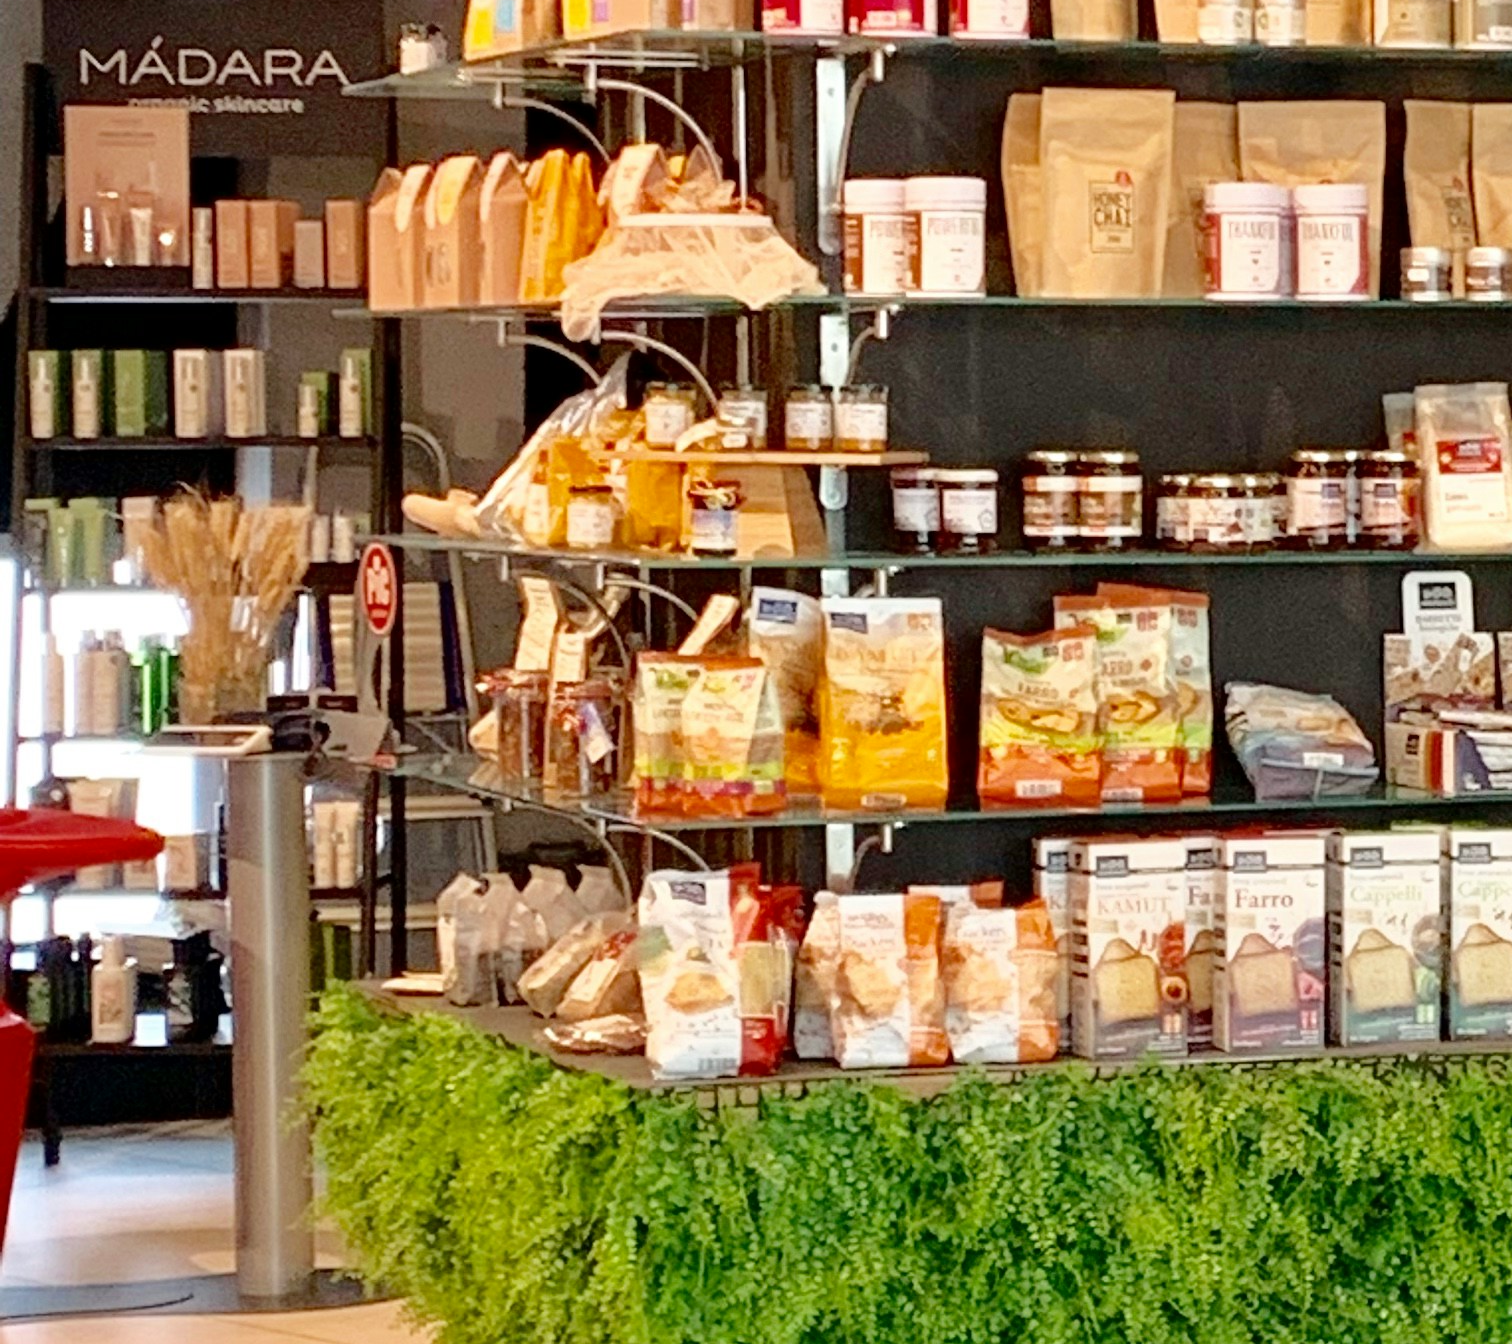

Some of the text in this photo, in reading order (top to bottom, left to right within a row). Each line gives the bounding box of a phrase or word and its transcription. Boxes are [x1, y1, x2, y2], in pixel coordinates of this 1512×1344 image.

[79, 34, 350, 86] MÁDARA
[213, 94, 305, 114] skincare
[1235, 886, 1294, 909] Farro
[1350, 884, 1423, 906] Cappelli
